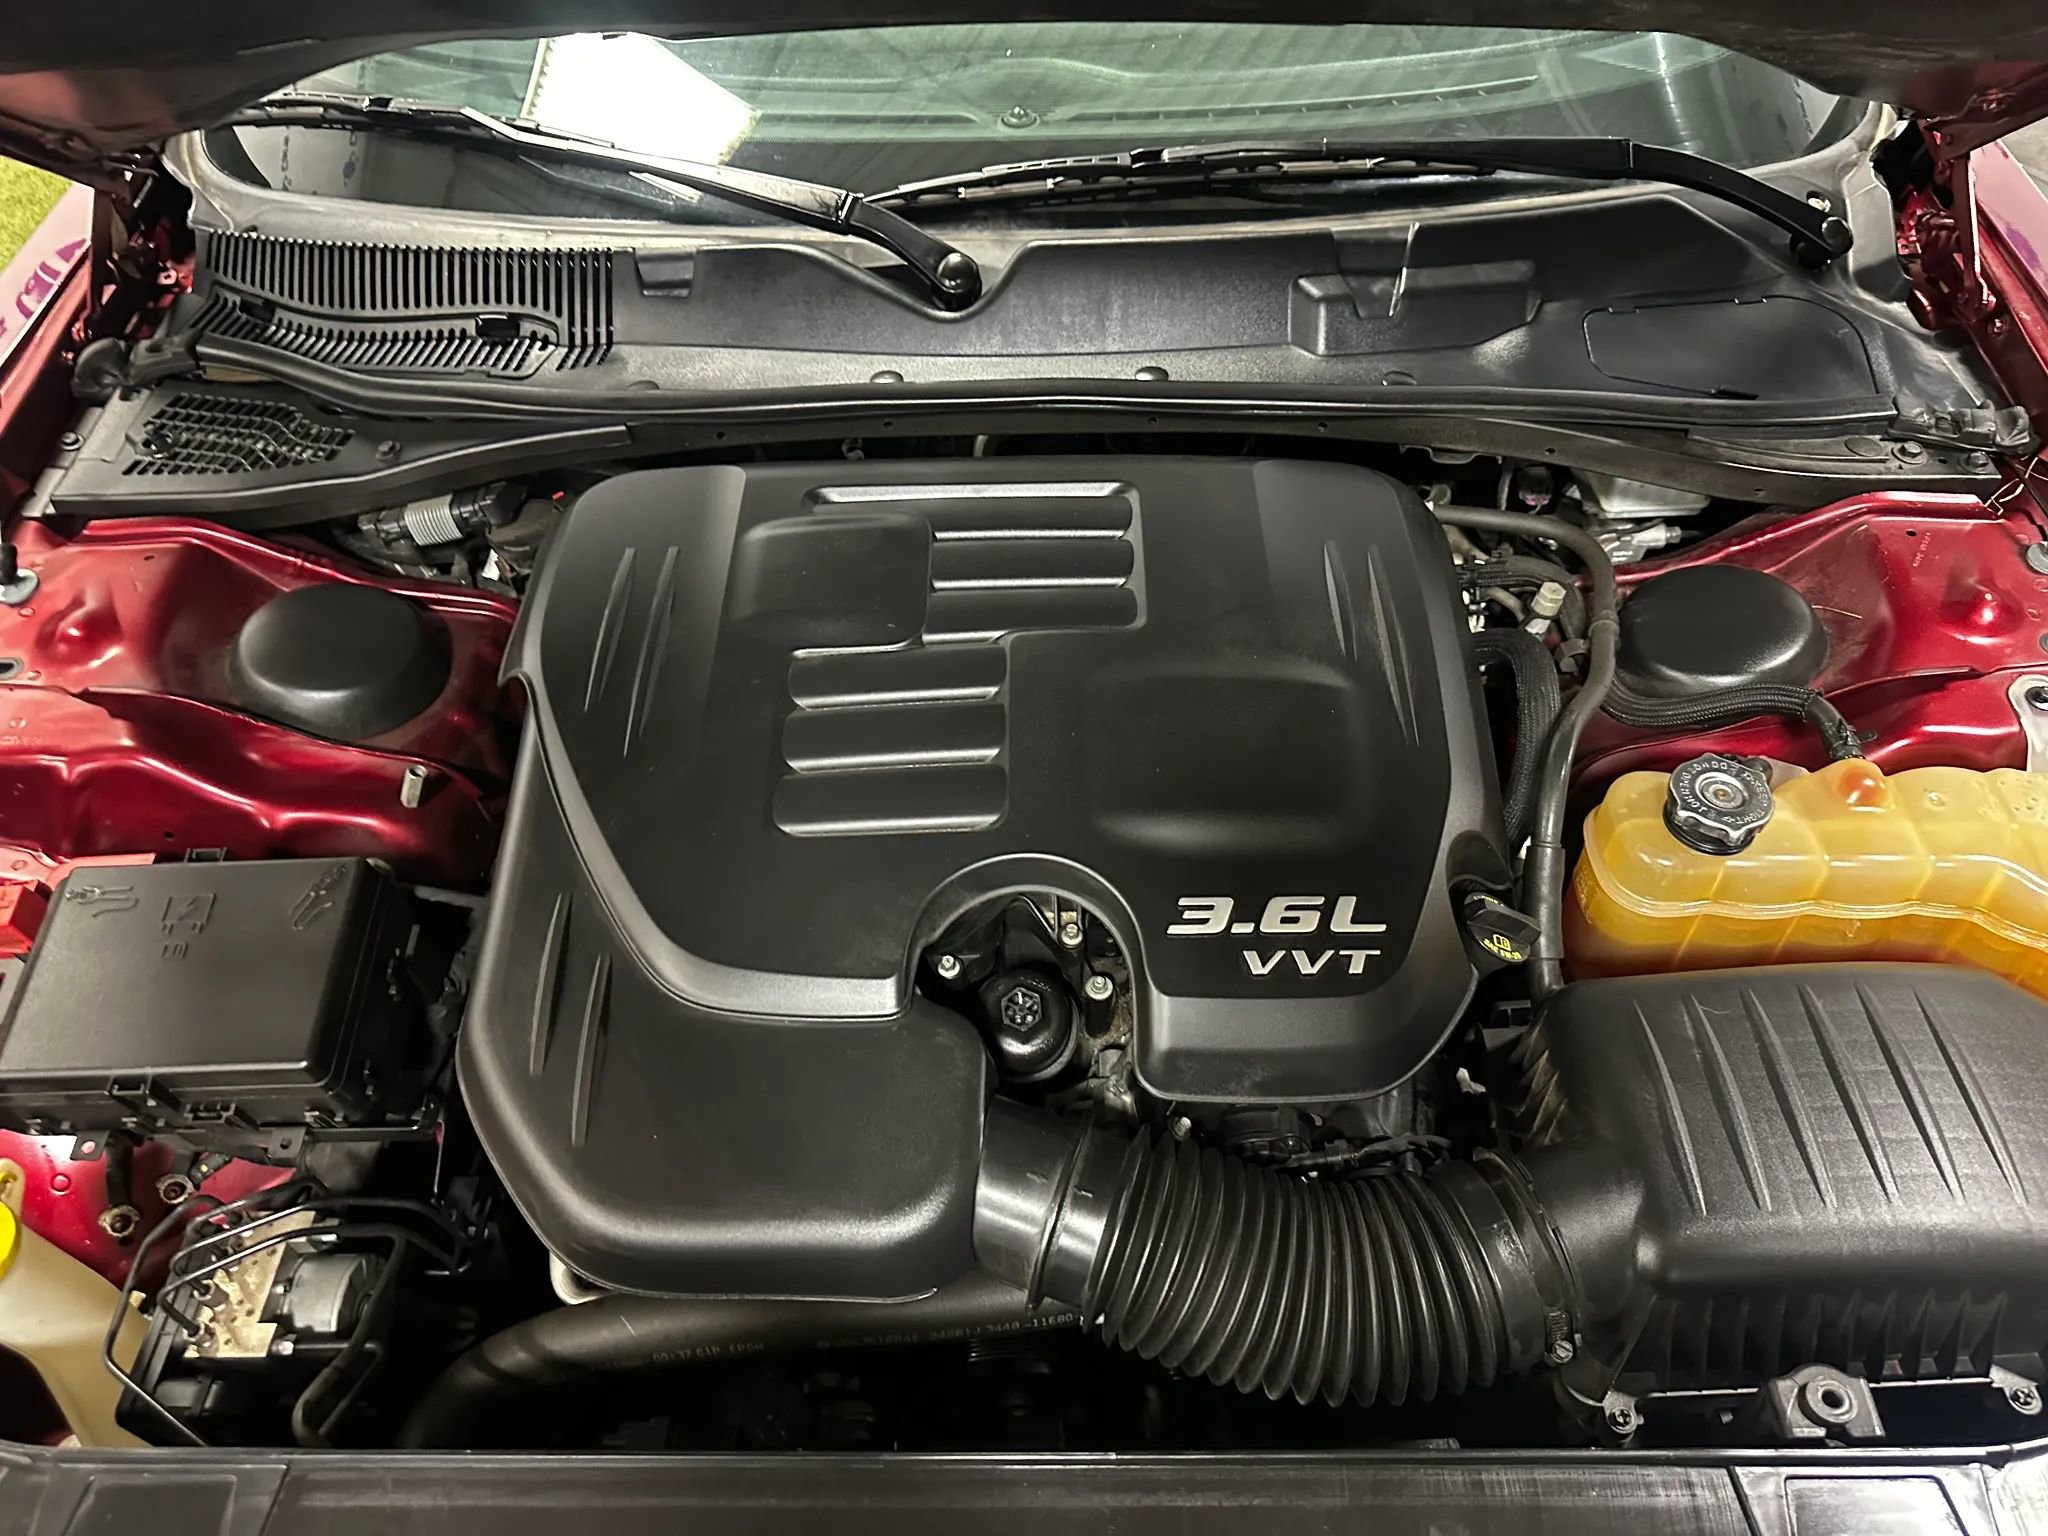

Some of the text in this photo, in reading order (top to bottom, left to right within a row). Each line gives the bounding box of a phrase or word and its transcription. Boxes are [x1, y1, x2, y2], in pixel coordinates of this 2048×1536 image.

[1680, 760, 1728, 813] DO NOT OPEN HOT
[1736, 780, 1769, 825] KEEP TIGHT
[1166, 896, 1387, 935] 3.6L
[1242, 949, 1381, 975] VVT
